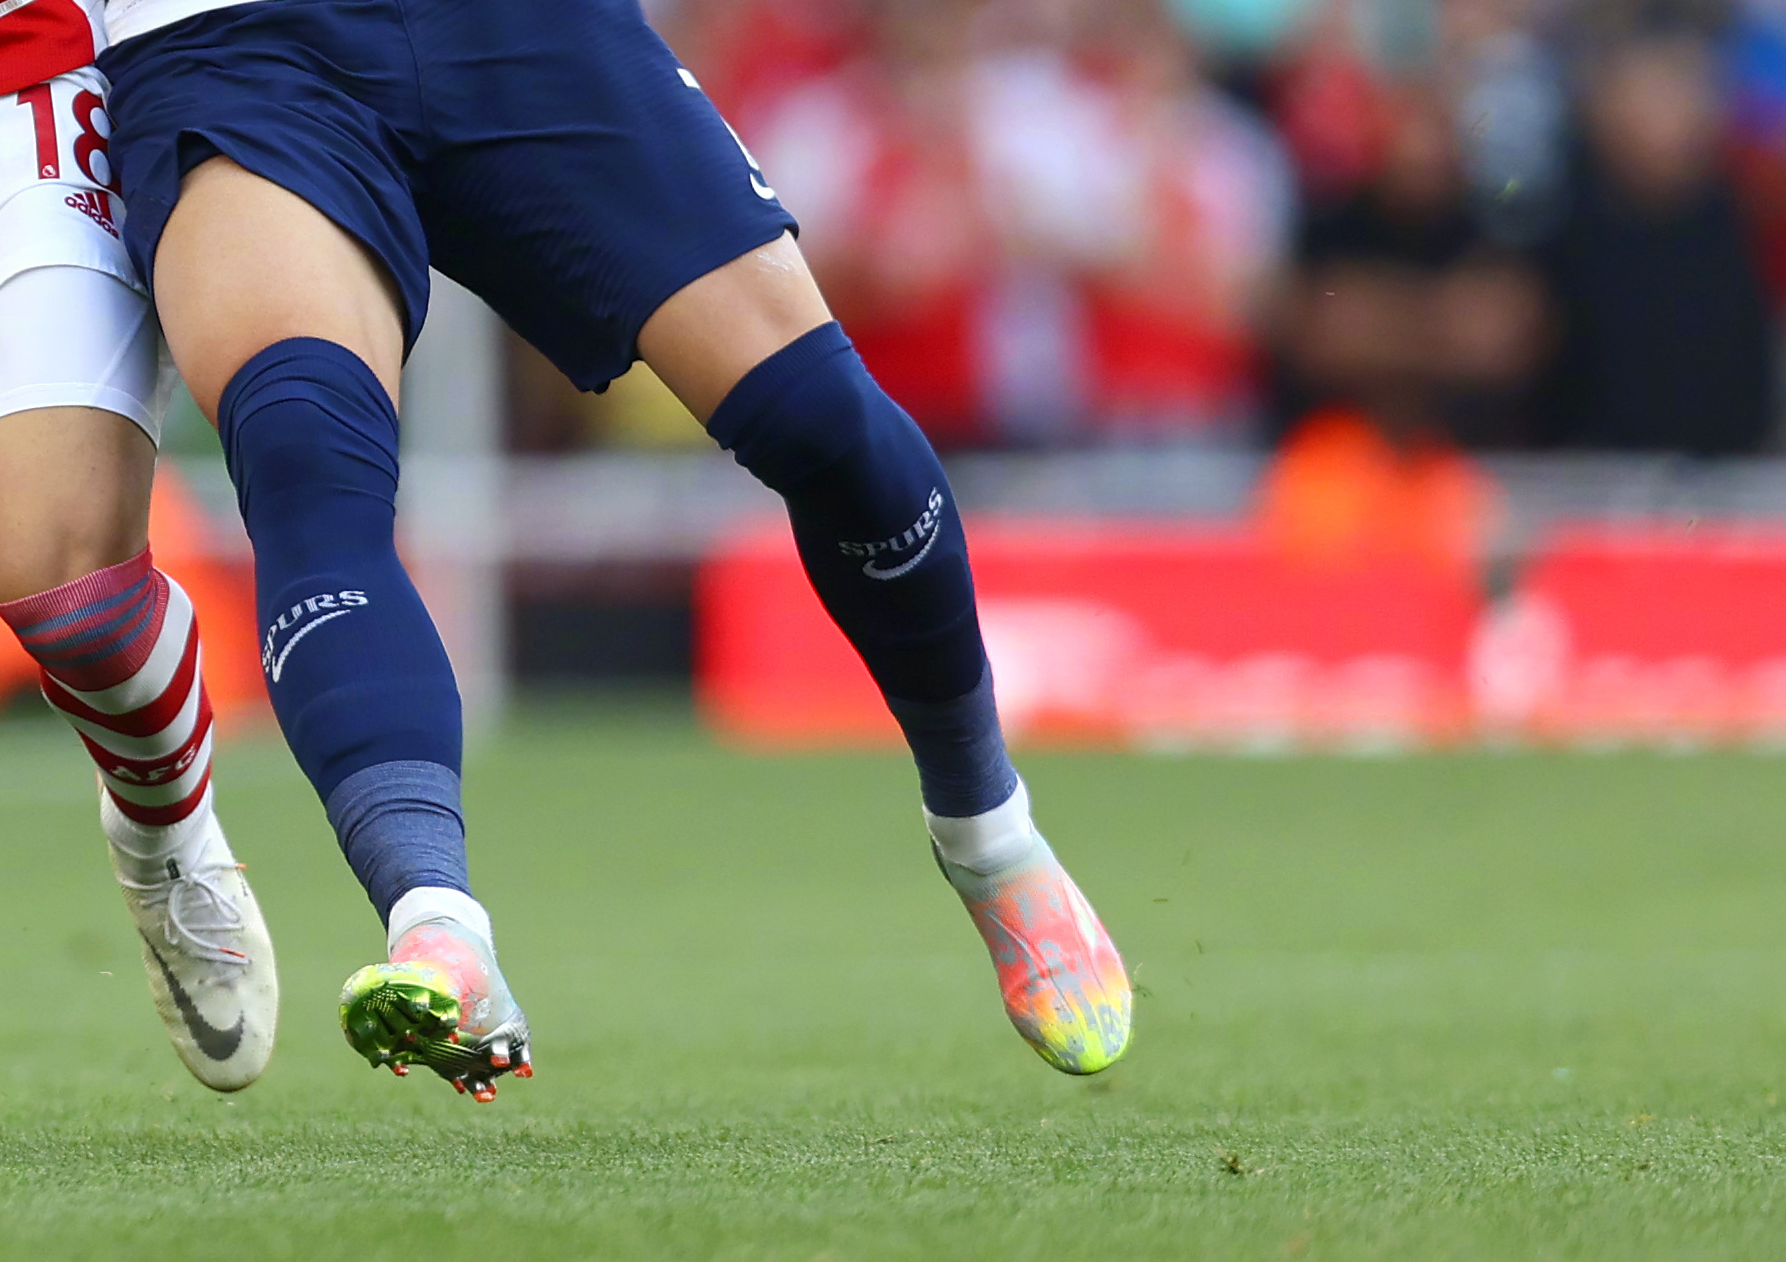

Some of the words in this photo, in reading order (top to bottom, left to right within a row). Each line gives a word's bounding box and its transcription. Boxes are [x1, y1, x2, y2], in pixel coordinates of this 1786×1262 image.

[17, 83, 122, 196] 18
[838, 486, 943, 556] SPURS
[262, 590, 369, 674] SPURS
